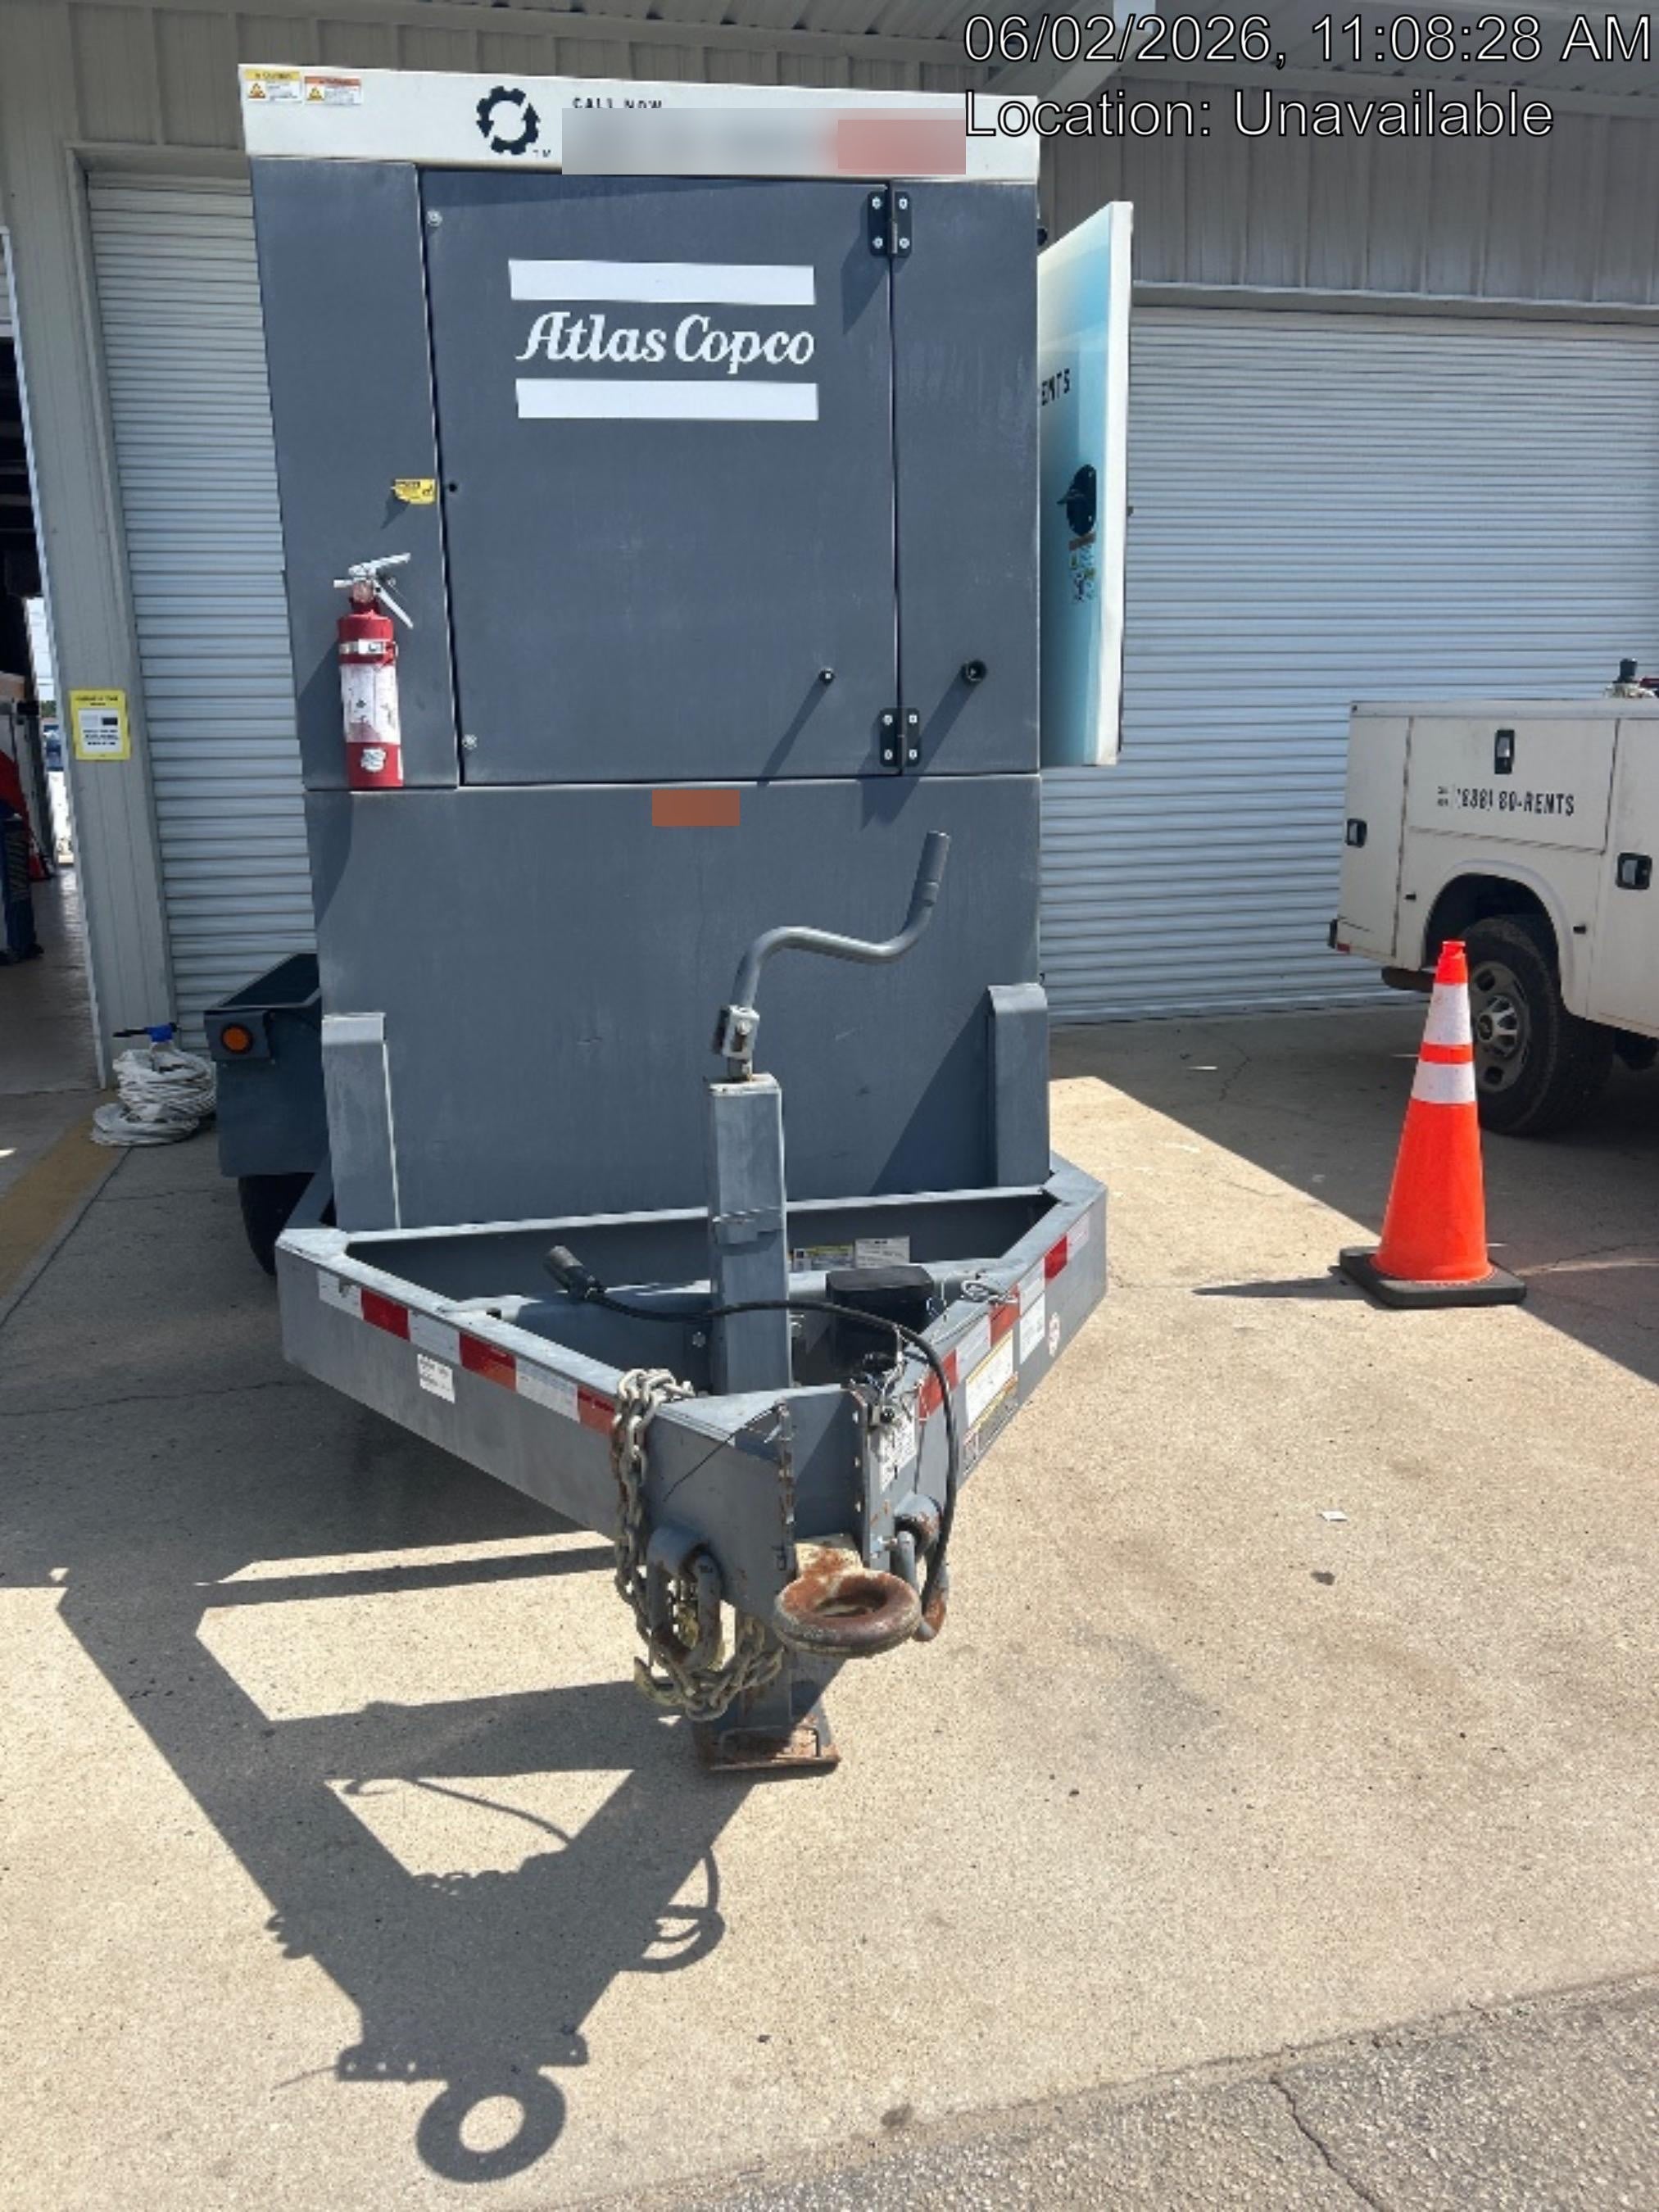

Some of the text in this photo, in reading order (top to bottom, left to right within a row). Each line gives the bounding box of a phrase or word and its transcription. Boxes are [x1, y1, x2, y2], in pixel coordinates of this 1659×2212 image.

[515, 311, 814, 374] Atlas Copco
[1041, 368, 1071, 407] ENTS
[1498, 790, 1575, 817] 80-RENTS
